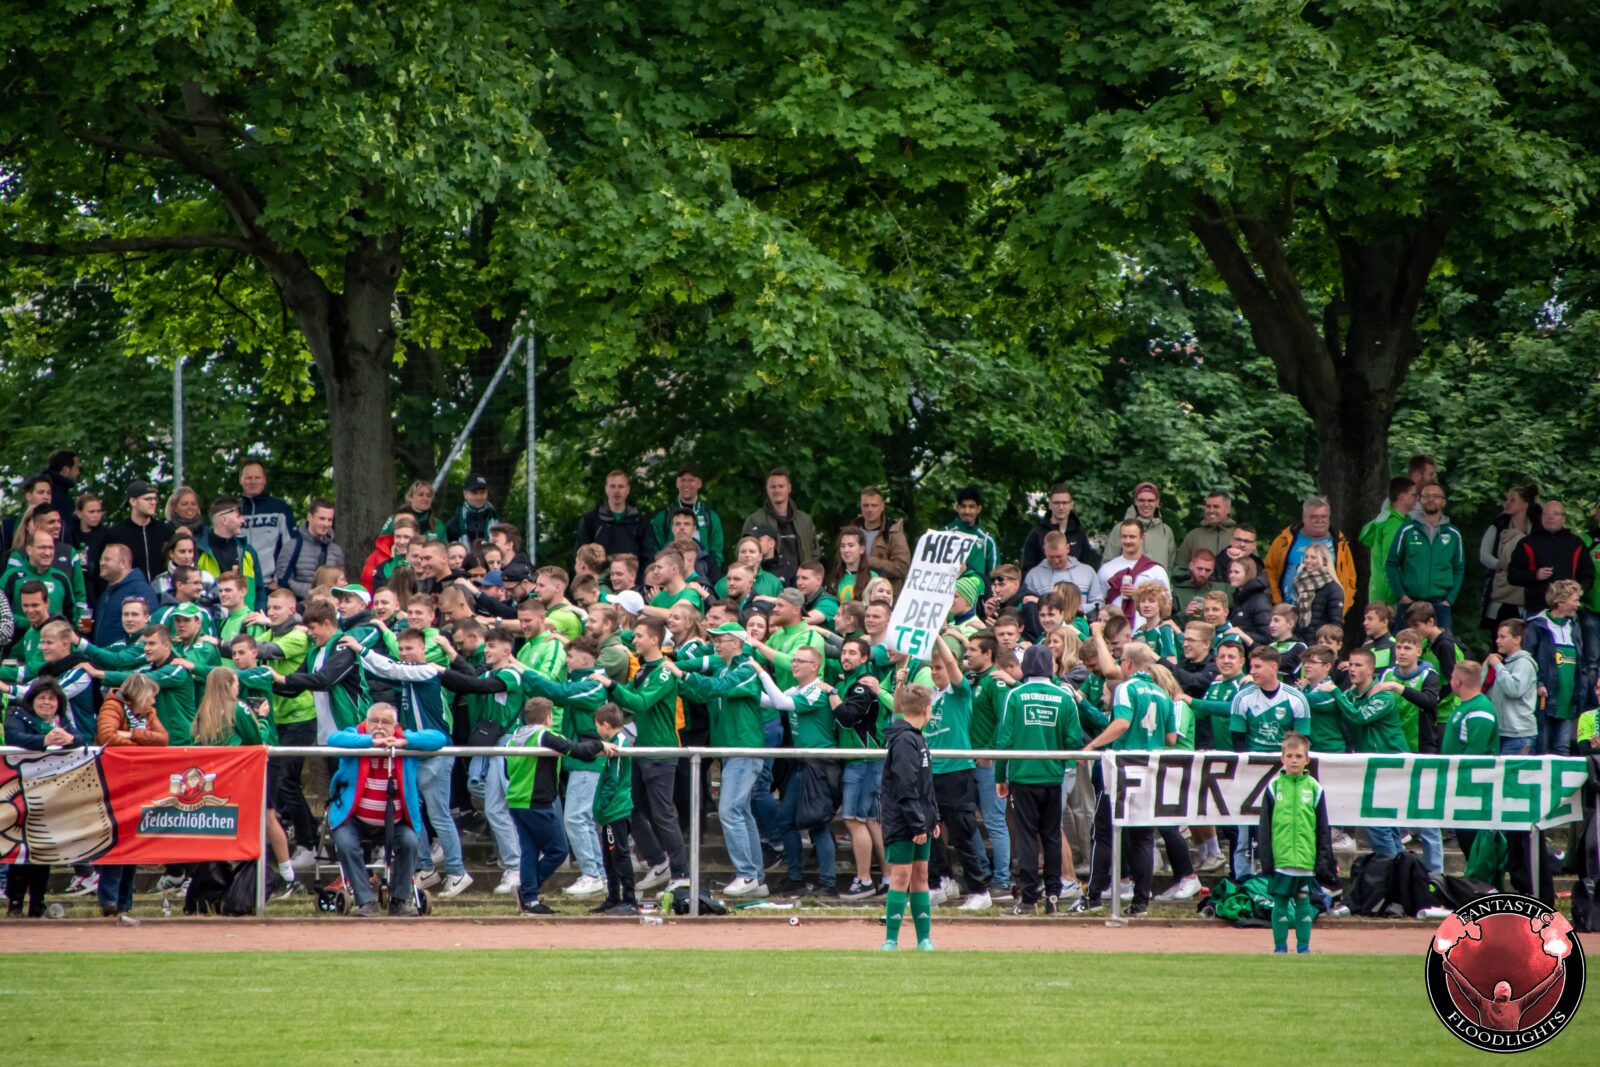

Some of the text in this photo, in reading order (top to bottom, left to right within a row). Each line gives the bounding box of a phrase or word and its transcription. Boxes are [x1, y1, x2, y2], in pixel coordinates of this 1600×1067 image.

[240, 516, 278, 529] ILLS
[921, 534, 974, 564] HIER
[903, 599, 944, 629] DER
[1142, 702, 1157, 737] 4
[1114, 755, 1589, 823] FORZ COSSE
